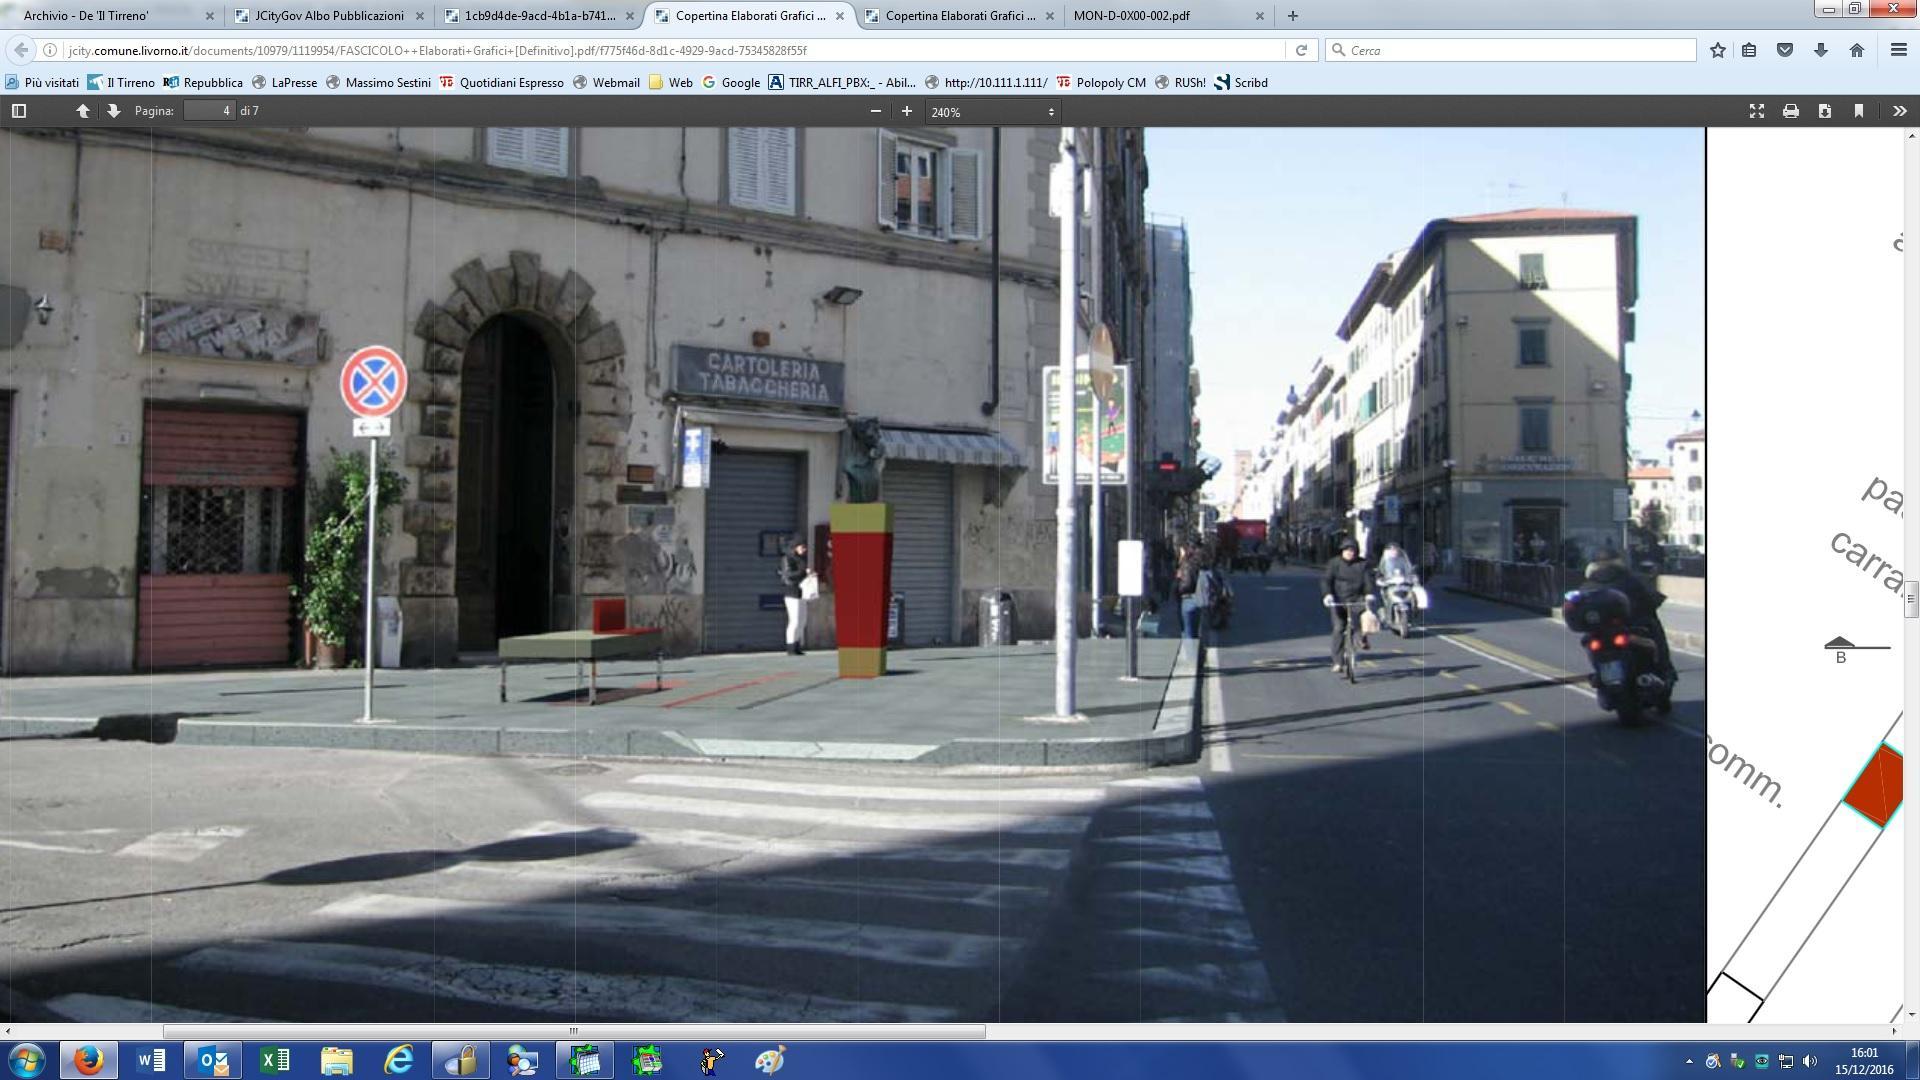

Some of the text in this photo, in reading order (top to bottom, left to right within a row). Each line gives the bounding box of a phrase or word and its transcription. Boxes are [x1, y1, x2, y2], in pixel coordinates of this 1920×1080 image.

[23, 10, 69, 21] Archivio
[79, 10, 94, 21] De
[96, 10, 105, 21] 'Il
[107, 10, 149, 21] Tirreno'
[255, 10, 404, 24] JCityGov Albo Pubblicazioni
[465, 10, 616, 21] 1cb9d4de-9acd-4b1a-b741...
[676, 10, 728, 24] Copertina
[731, 10, 777, 21] Elaborati
[780, 10, 814, 21] Grafici
[886, 10, 938, 24] Copertina
[941, 10, 987, 21] Elaborati
[990, 10, 1024, 21] Grafici
[1074, 10, 1191, 24] MON-D-0X00-002.pdf
[1351, 45, 1381, 56] Cerca
[25, 77, 79, 88] Più visitati
[107, 77, 155, 88] Il Tirreno
[184, 77, 243, 91] Repubblica
[272, 77, 318, 88] LaPresse
[346, 77, 395, 88] Massimo
[397, 77, 432, 88] Sestini
[460, 77, 516, 90] Quotidiani
[519, 77, 565, 91] Espresso
[592, 77, 640, 88] Webmail
[668, 77, 694, 88] Web
[722, 77, 761, 91] Google
[885, 77, 916, 88] Abil...
[945, 77, 1049, 91] http://10.111.1.111/
[1077, 77, 1125, 91] Polopoly
[1127, 77, 1146, 88] CM
[1175, 77, 1206, 88] RUSh!
[1235, 77, 1268, 88] Scribd
[135, 105, 174, 119] Pagina:
[223, 105, 230, 116] 4
[240, 105, 260, 116] di 7
[931, 107, 961, 118] 240%
[708, 352, 821, 382] CARTOLERIA
[698, 372, 830, 402] TABACCHERIA
[1861, 477, 1903, 519] pa
[1831, 533, 1903, 598] carra
[1837, 652, 1847, 664] B
[1851, 1047, 1879, 1058] 16:01
[1835, 1064, 1895, 1076] 15/12/2016
